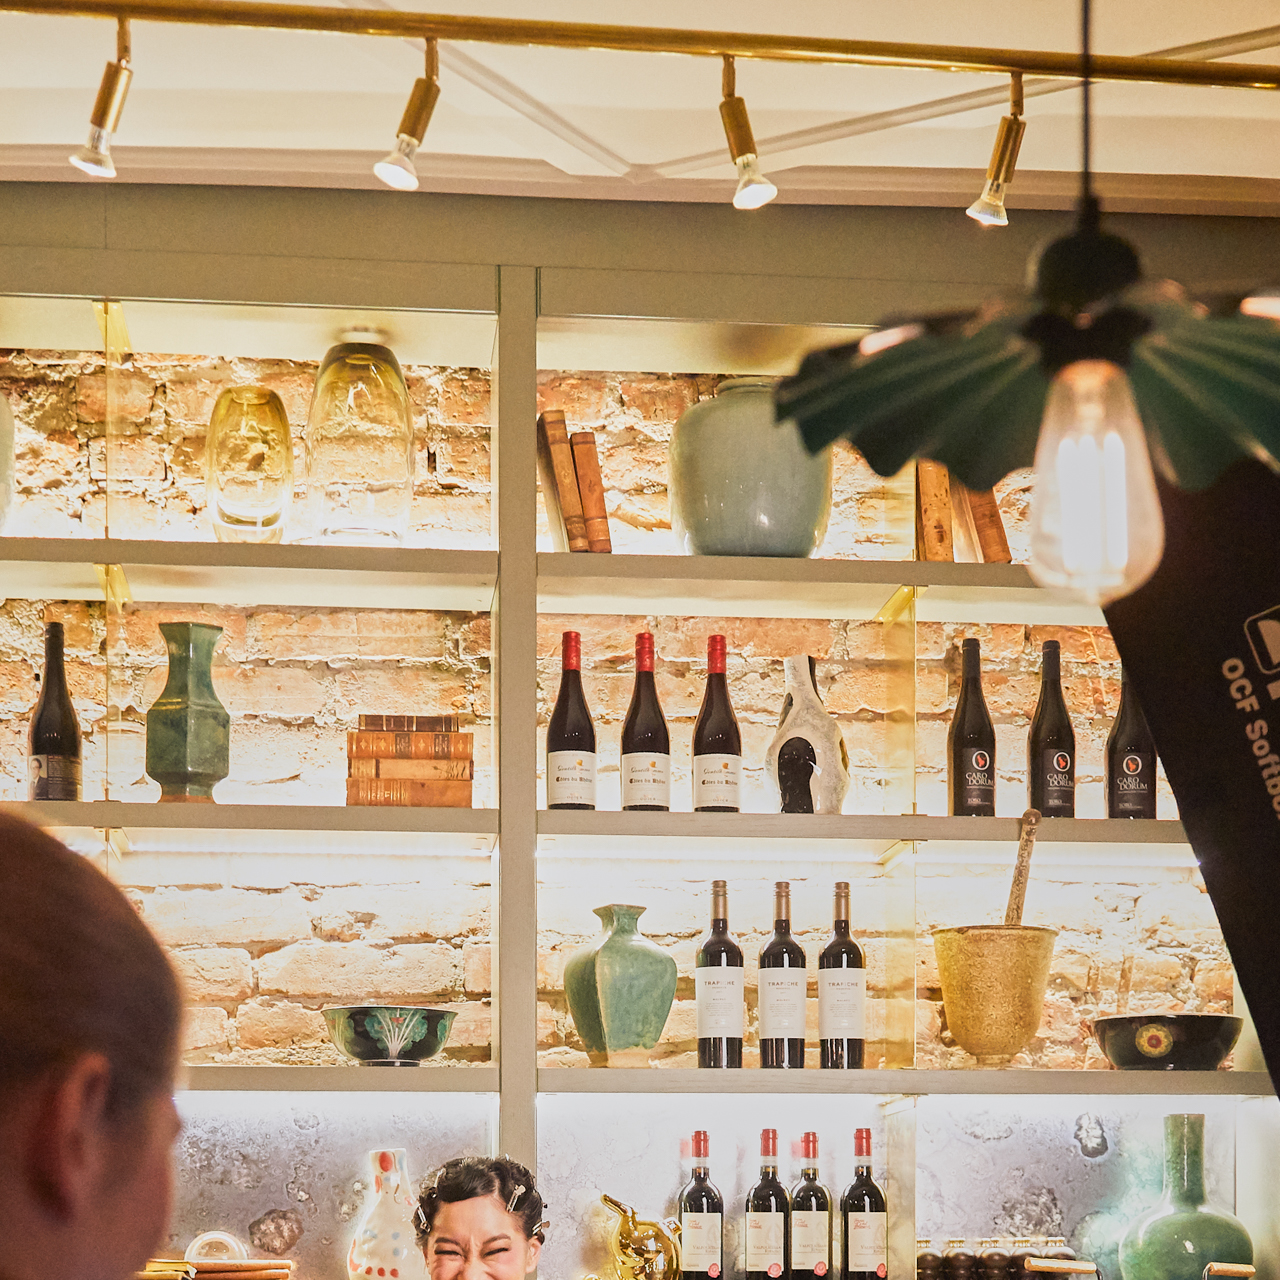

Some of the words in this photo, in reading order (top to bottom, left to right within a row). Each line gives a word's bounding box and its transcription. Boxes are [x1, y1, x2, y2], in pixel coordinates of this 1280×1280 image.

[1222, 657, 1260, 713] OCF
[965, 772, 988, 780] CARO
[1046, 773, 1069, 781] CARO
[1116, 776, 1140, 785] CARO
[1119, 782, 1148, 790] DORUM
